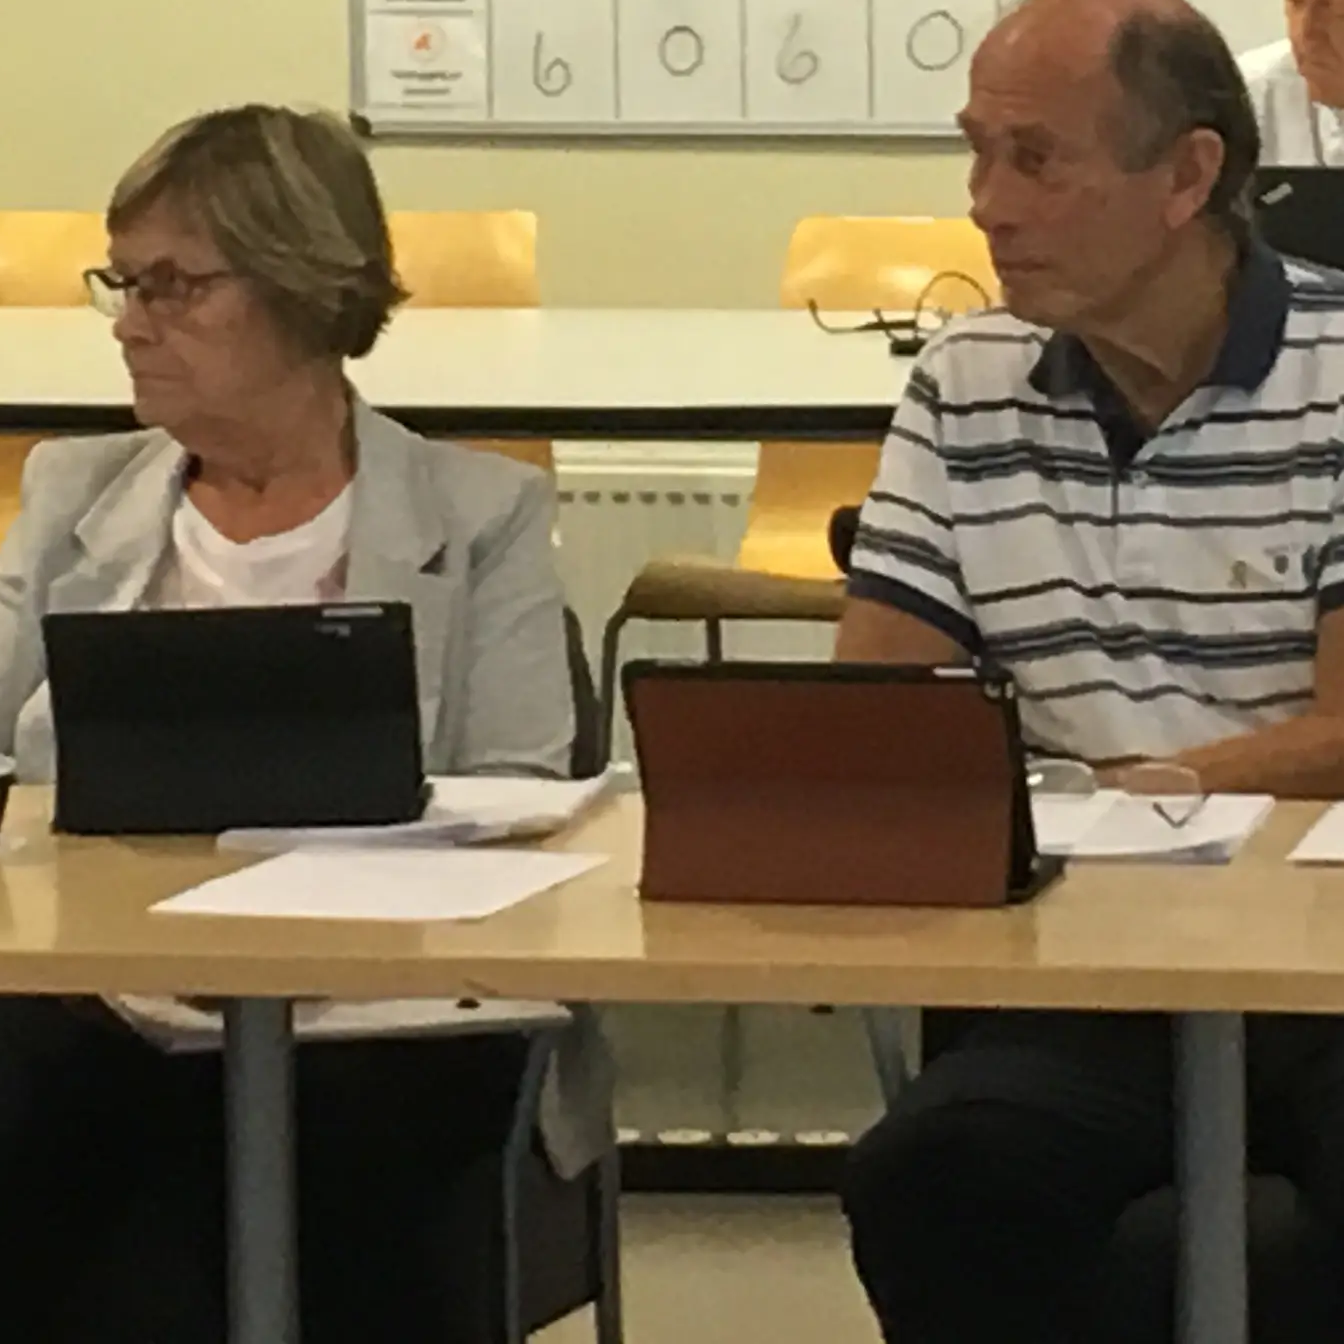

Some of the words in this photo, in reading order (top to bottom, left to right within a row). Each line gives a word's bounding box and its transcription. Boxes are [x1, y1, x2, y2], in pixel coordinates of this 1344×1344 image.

[533, 30, 572, 97] 6
[658, 24, 705, 78] 0
[775, 13, 818, 85] 6
[906, 10, 964, 71] 0
